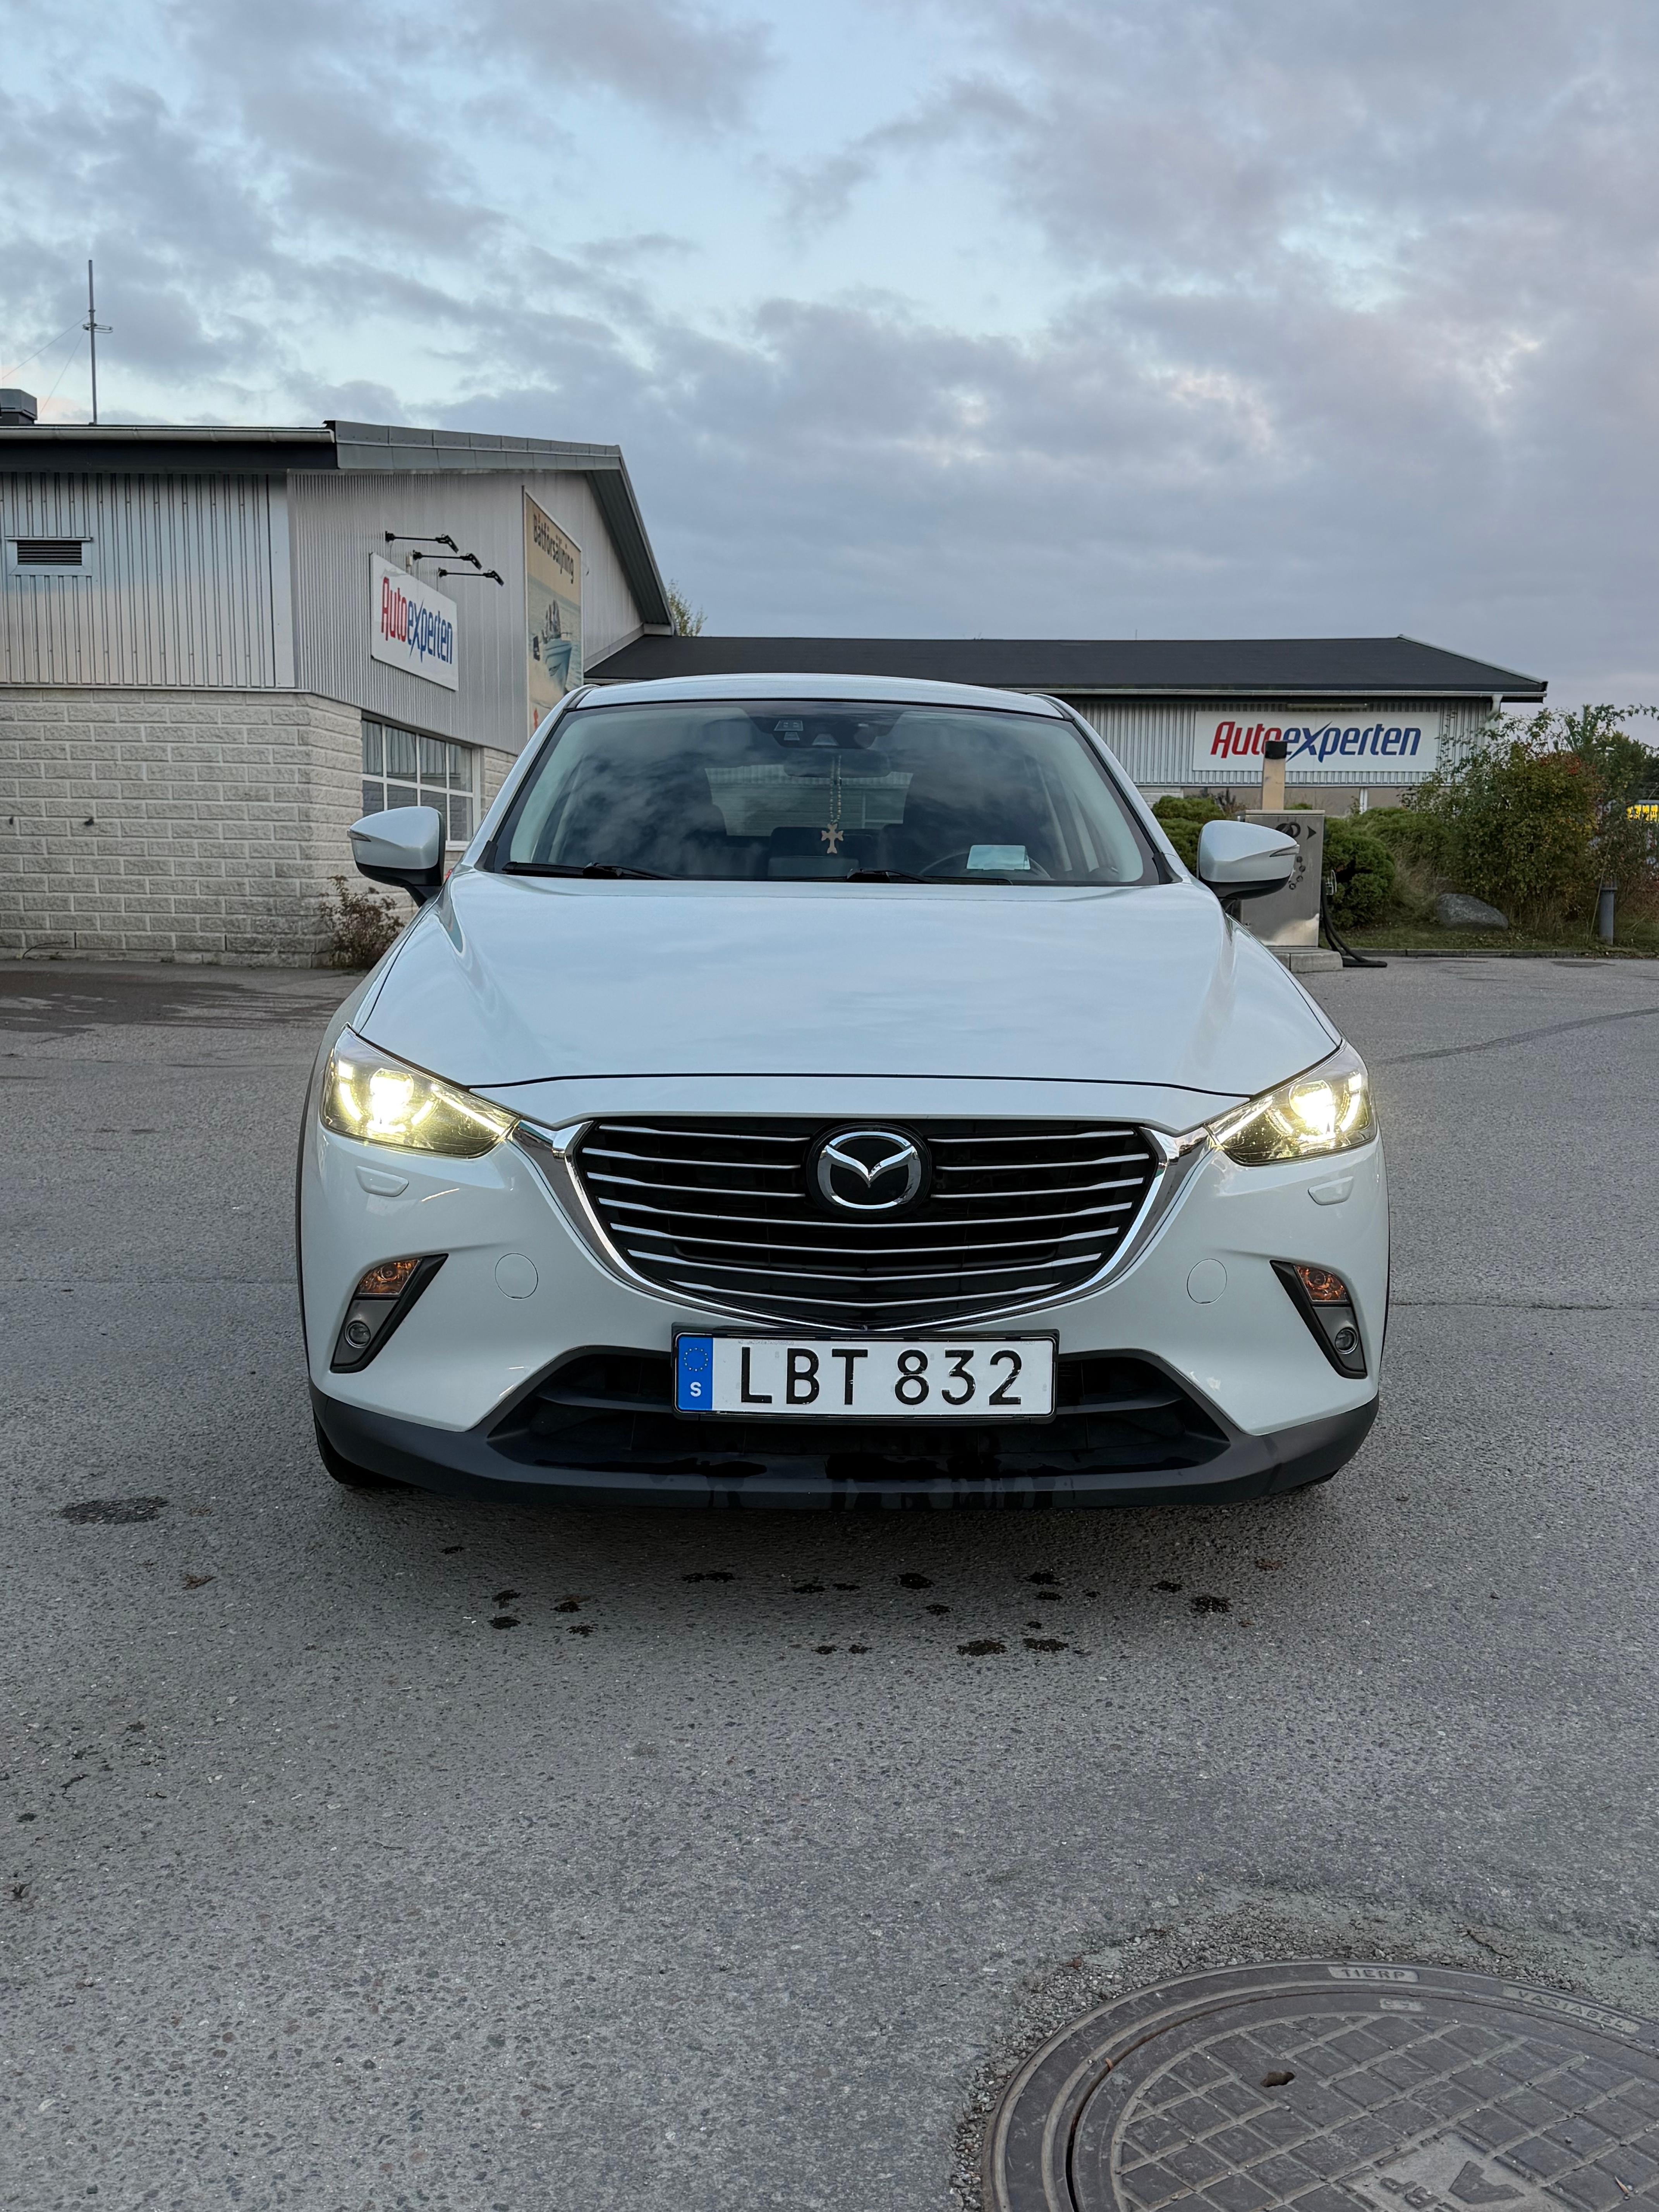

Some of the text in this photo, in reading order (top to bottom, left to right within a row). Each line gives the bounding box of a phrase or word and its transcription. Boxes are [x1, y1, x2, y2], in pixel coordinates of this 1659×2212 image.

[381, 576, 453, 665] Autoexperten
[690, 1381, 701, 1397] S
[741, 1346, 1022, 1406] LBT 832
[1341, 1969, 1405, 1979] TIERP
[1519, 1990, 1623, 2028] VARIABEL
